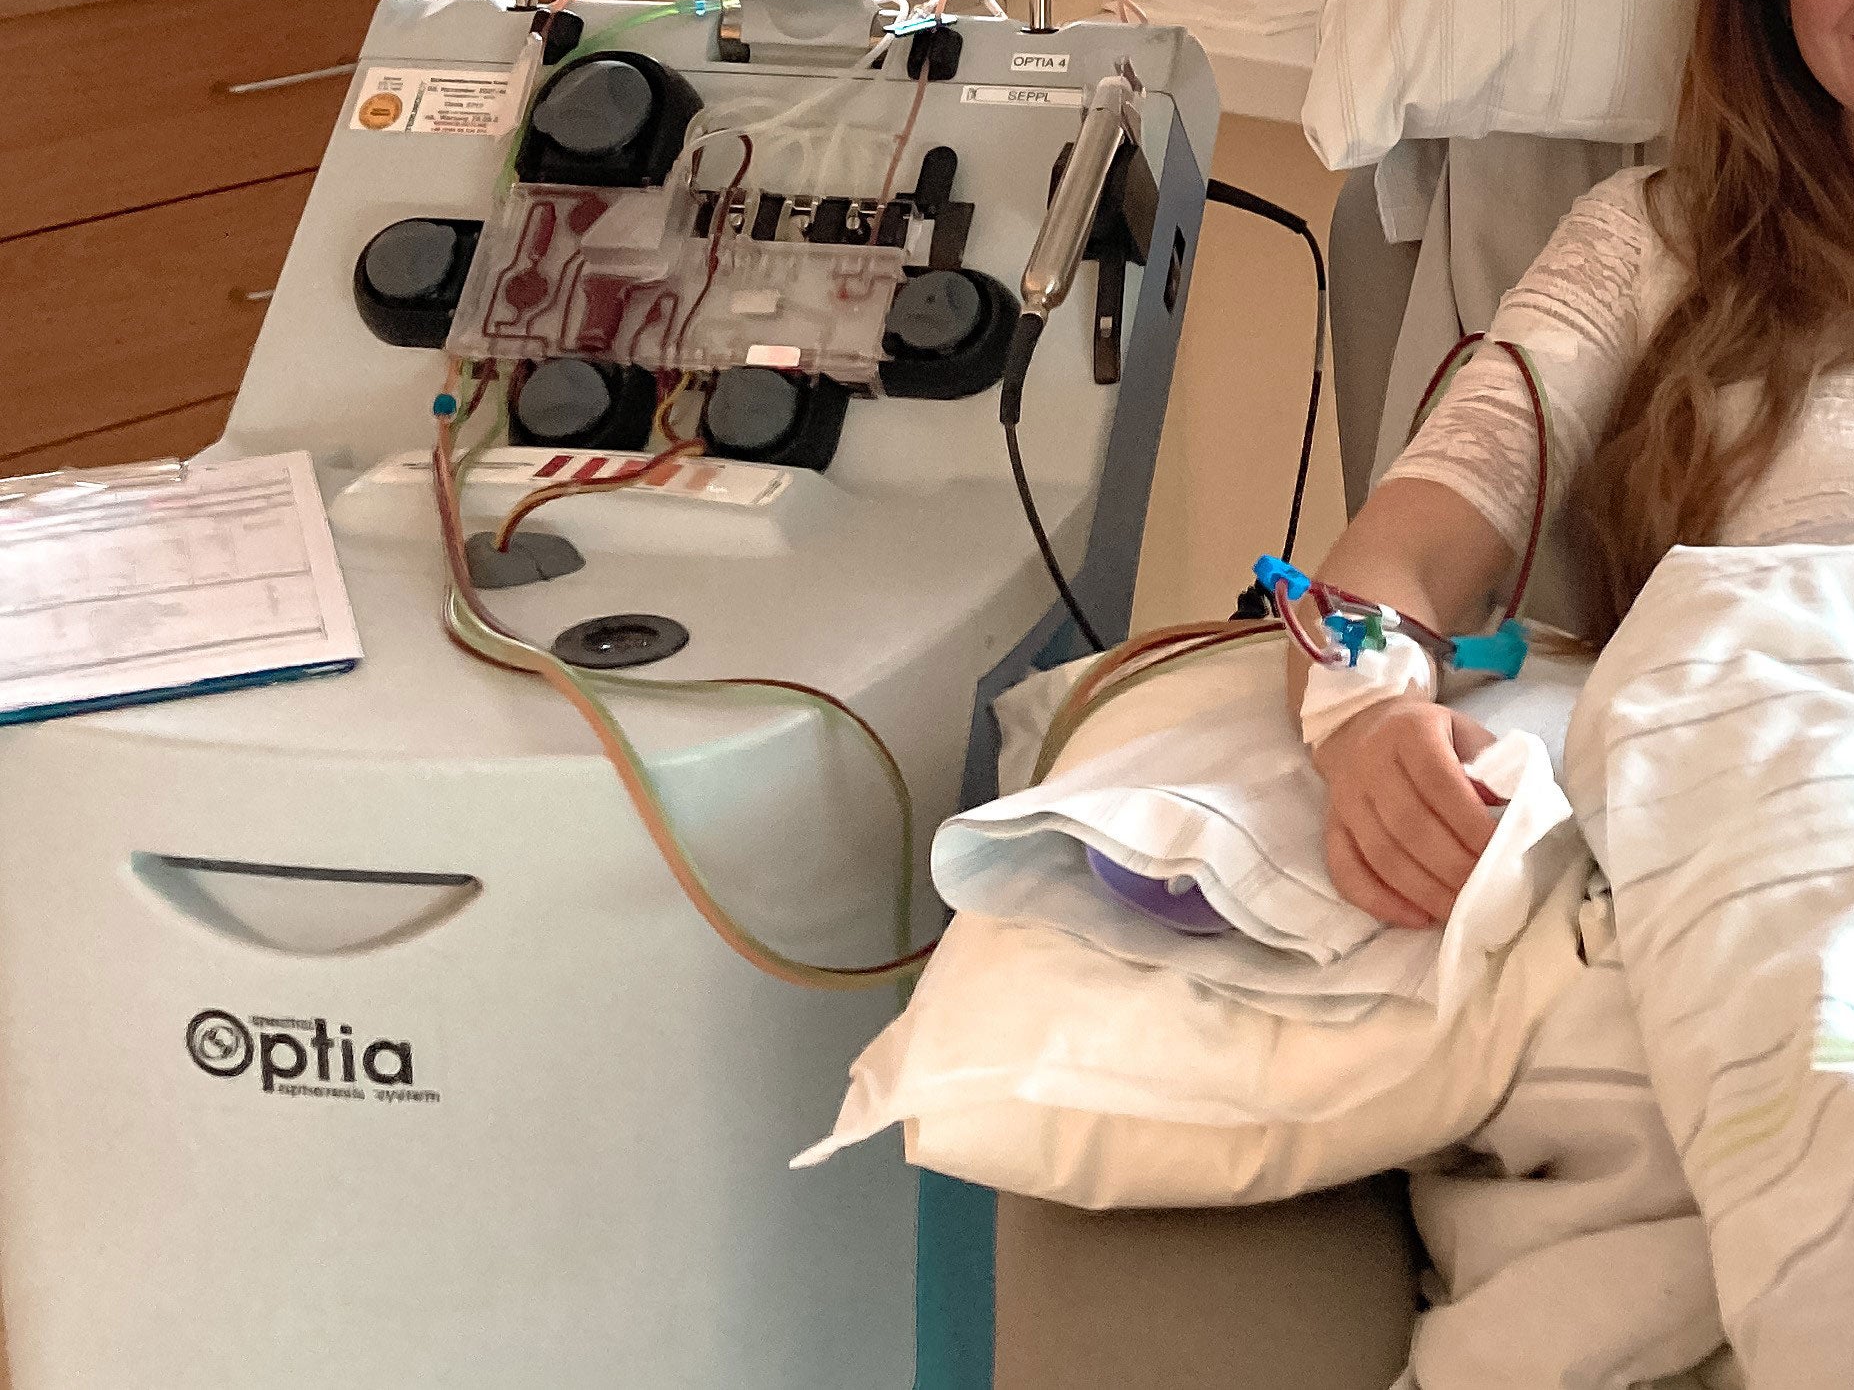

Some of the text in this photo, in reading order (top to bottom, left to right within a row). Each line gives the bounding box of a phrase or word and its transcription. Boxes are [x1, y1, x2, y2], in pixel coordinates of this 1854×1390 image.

[1013, 55, 1067, 68] OPTIA 4
[1007, 90, 1052, 103] SEPPL
[185, 1009, 414, 1094] Optia
